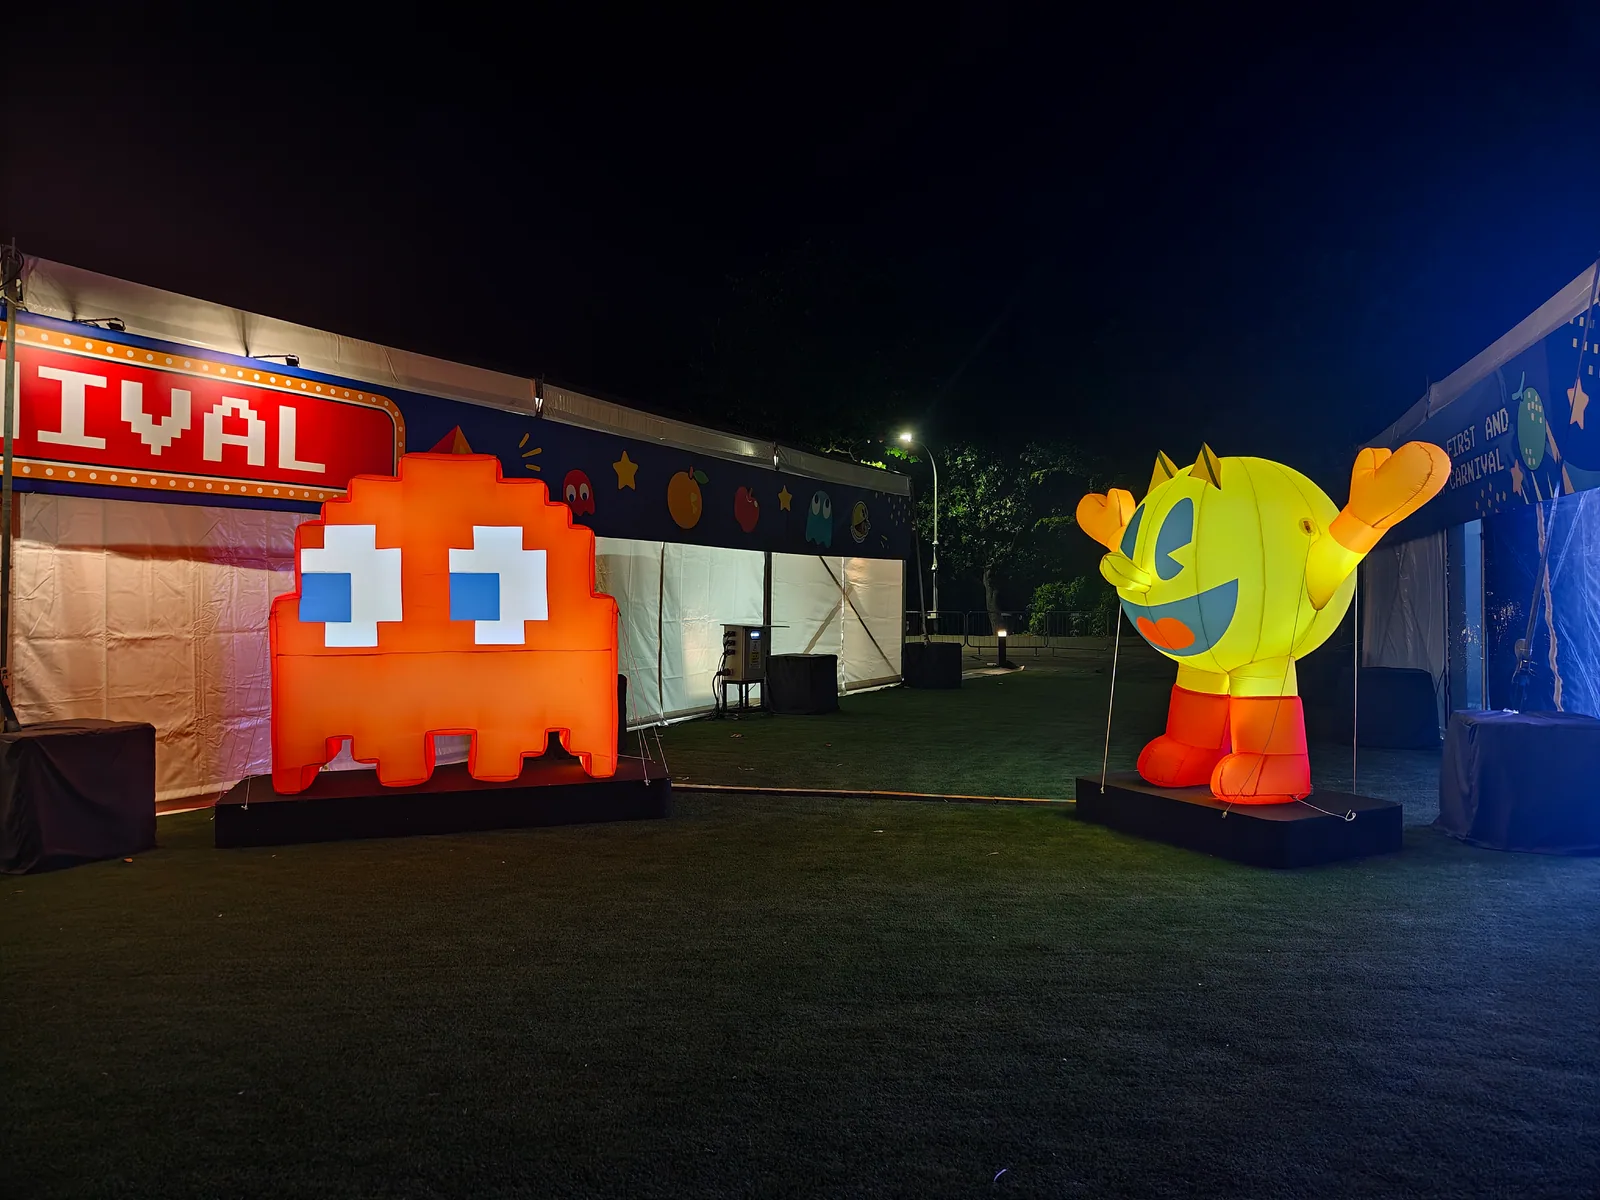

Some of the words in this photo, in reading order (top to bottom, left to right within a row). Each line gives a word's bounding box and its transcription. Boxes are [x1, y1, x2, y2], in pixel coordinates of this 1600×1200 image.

[1446, 425, 1476, 458] FIRST
[1485, 407, 1509, 440] AND
[1450, 448, 1504, 489] CARNIVAL
